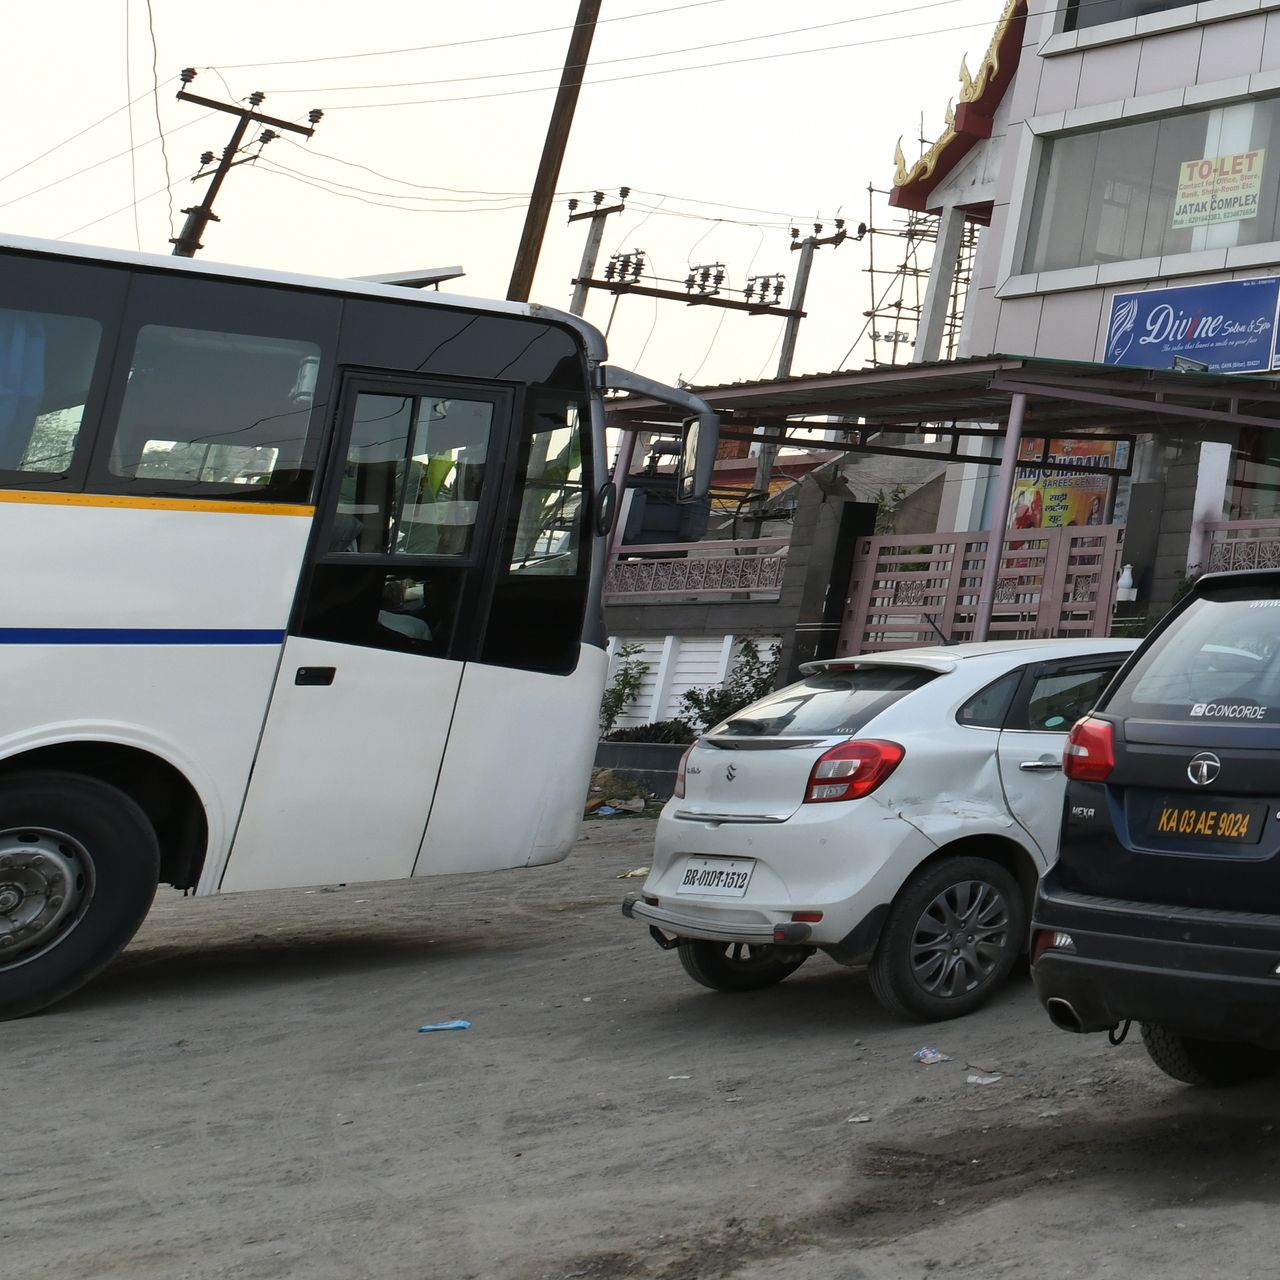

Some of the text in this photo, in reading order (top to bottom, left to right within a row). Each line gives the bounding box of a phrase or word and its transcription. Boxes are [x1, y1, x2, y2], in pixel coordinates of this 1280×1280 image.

[1186, 152, 1259, 181] TO-LET
[1175, 193, 1258, 216] JATAK COMPLEX
[1139, 304, 1224, 345] Divine
[1042, 478, 1073, 488] SAREES
[1204, 703, 1267, 719] CONCORDE
[1158, 808, 1250, 837] KA 03 AE 9024
